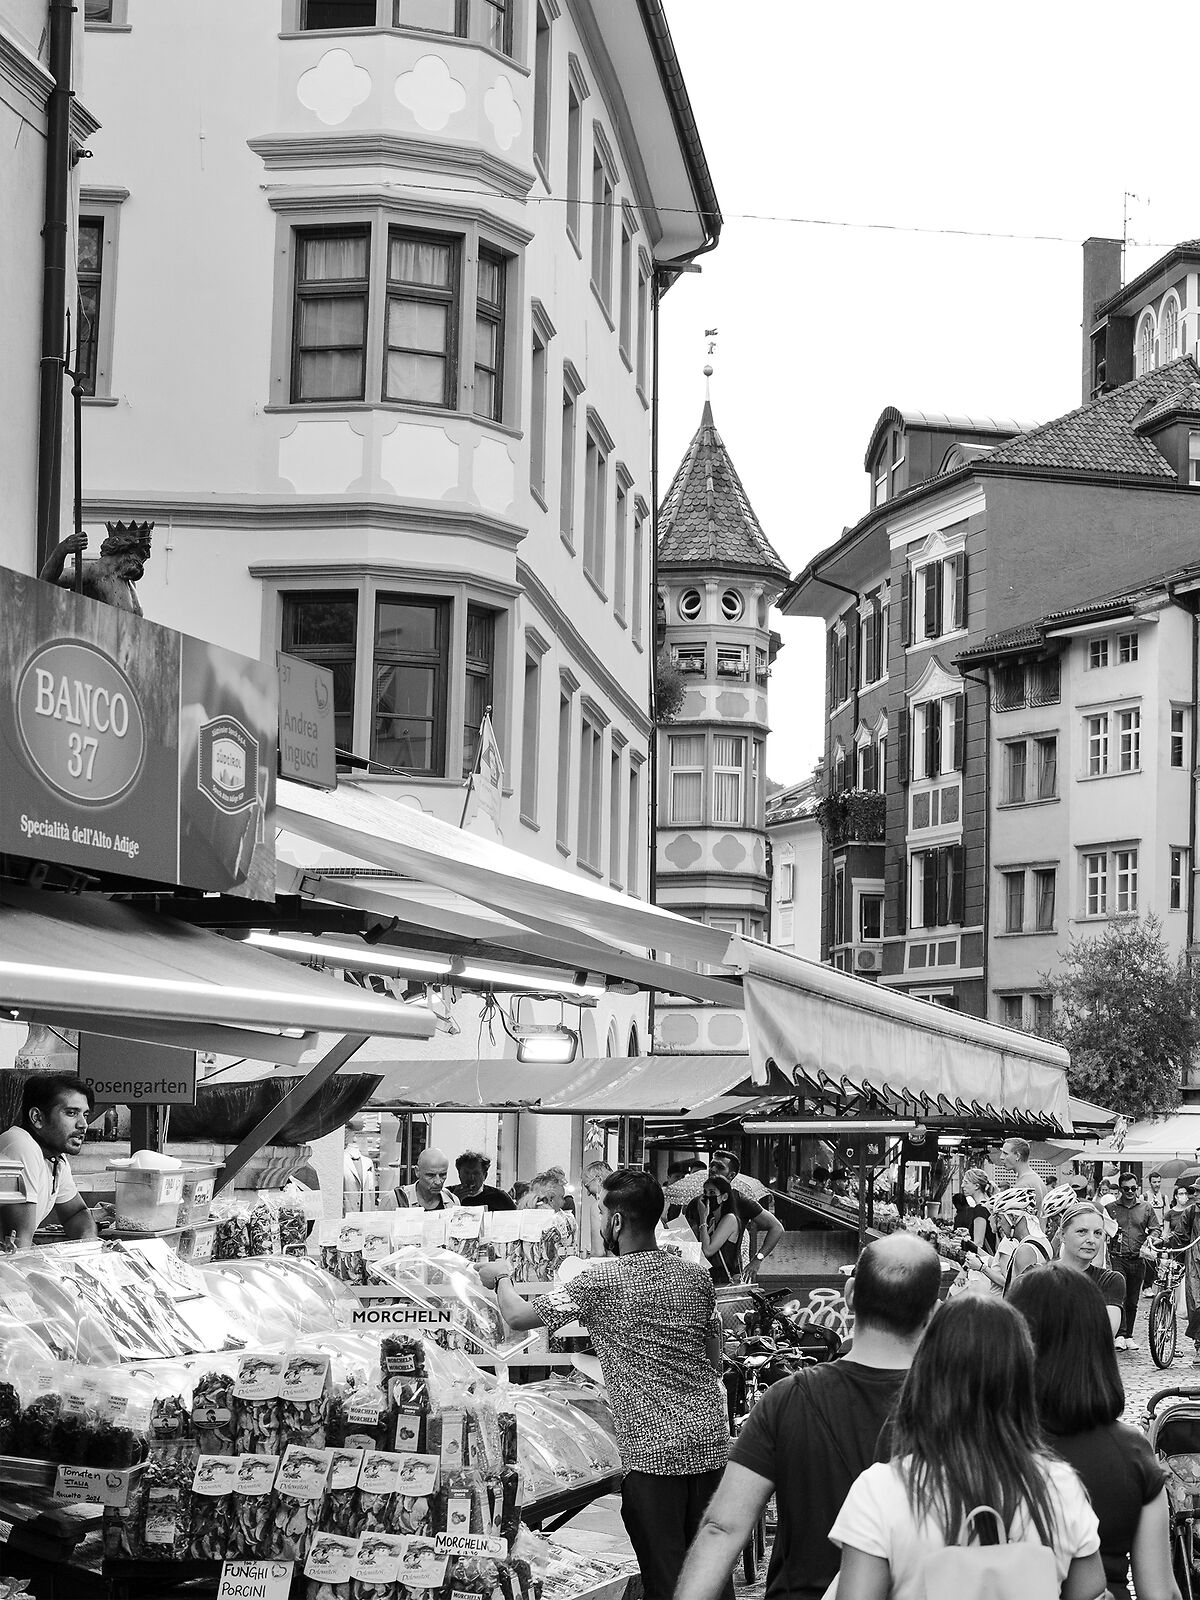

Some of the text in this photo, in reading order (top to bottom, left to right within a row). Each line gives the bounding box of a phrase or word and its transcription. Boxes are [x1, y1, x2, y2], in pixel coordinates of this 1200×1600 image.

[281, 664, 292, 682] 37
[35, 668, 129, 737] BANCO
[283, 708, 318, 740] Andrea
[67, 732, 99, 781] 37
[284, 738, 319, 771] Ingusci
[20, 814, 140, 859] Specialità dell'Alto Adige
[352, 1310, 451, 1323] MORCHELN
[61, 1466, 101, 1480] Tomaten
[64, 1479, 89, 1488] ITALIA
[436, 1535, 488, 1551] MORCHELN
[224, 1563, 269, 1581] FUNGHI
[221, 1581, 266, 1598] PORCINI
